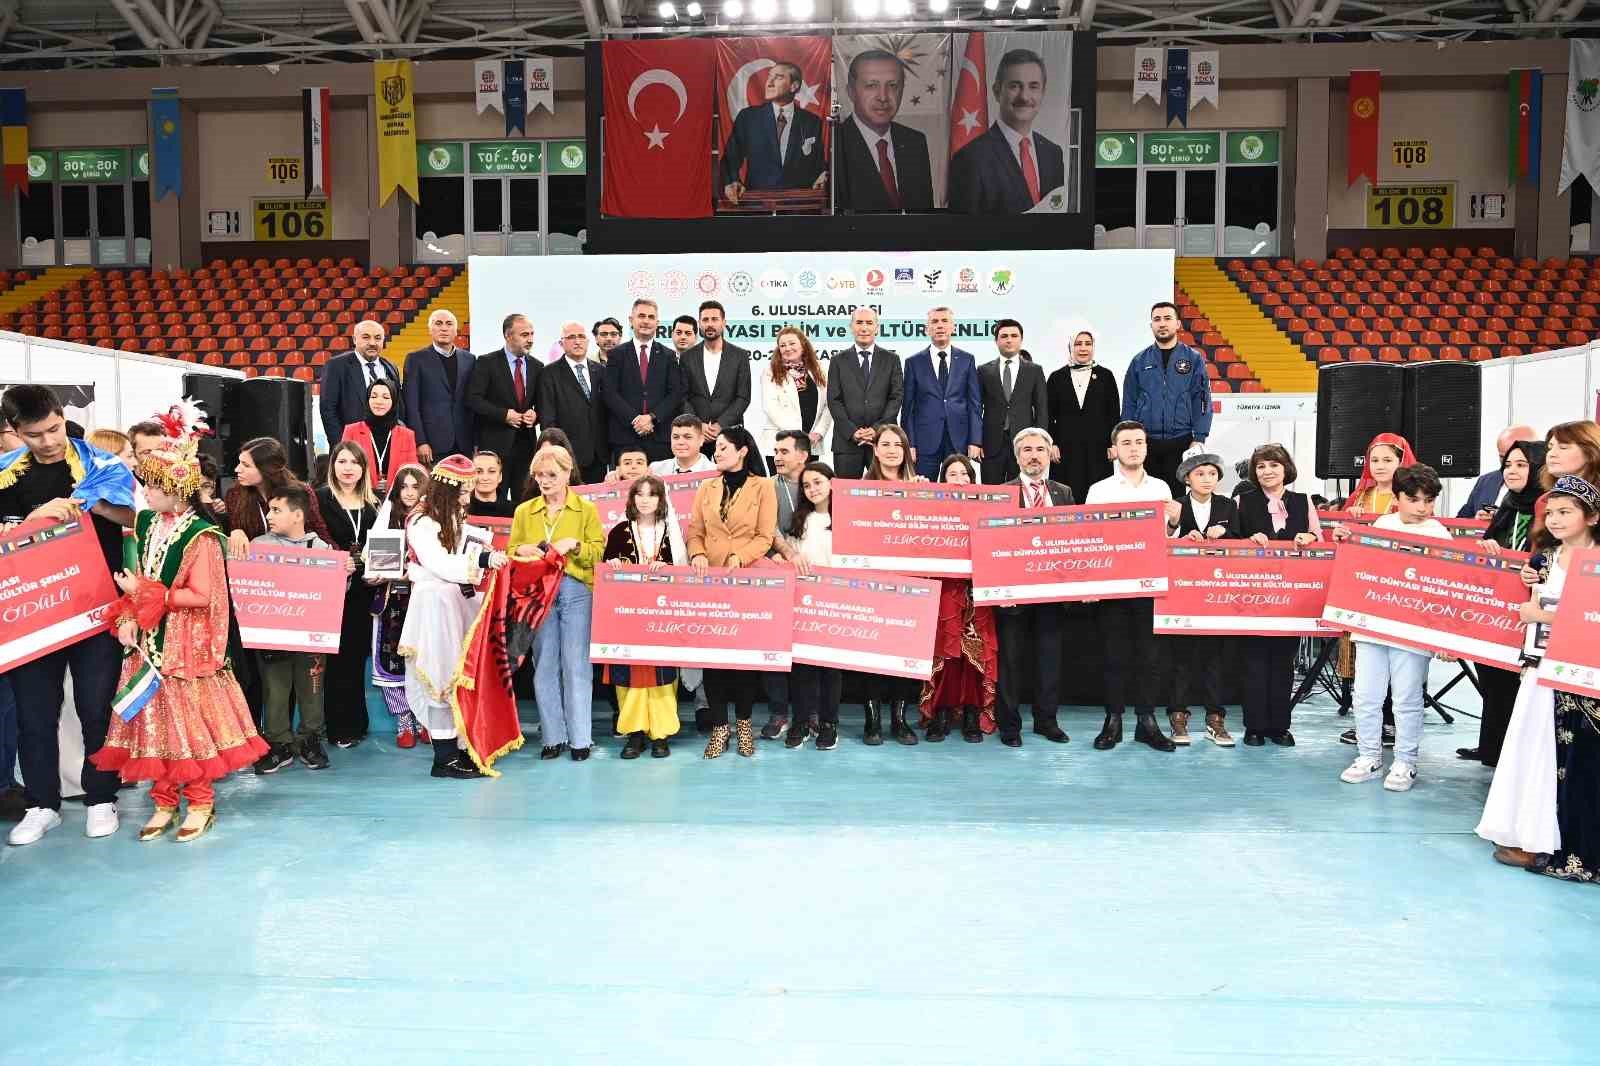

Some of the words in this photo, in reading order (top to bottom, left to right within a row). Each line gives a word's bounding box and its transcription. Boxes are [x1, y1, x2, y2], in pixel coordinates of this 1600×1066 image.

[1394, 147, 1426, 164] 108
[270, 164, 298, 180] 106
[1374, 197, 1444, 225] 108
[262, 211, 324, 238] 106
[752, 305, 764, 316] 6.
[826, 325, 846, 337] ve
[892, 509, 904, 521] 6.
[1032, 536, 1044, 548] 6.
[40, 564, 80, 588] ŞENLİĞİ
[1214, 568, 1224, 579] 6.
[1404, 568, 1420, 581] 6.
[1420, 576, 1494, 596] ULUSLARARASI
[1355, 570, 1378, 584] TÜRK
[1380, 576, 1420, 592] DÜNYASI
[1422, 584, 1449, 598] BİLİM
[1451, 591, 1464, 600] VE
[1466, 593, 1506, 610] KÜLTÜR
[656, 595, 668, 607] 6.
[1584, 610, 1600, 623] TÜ
